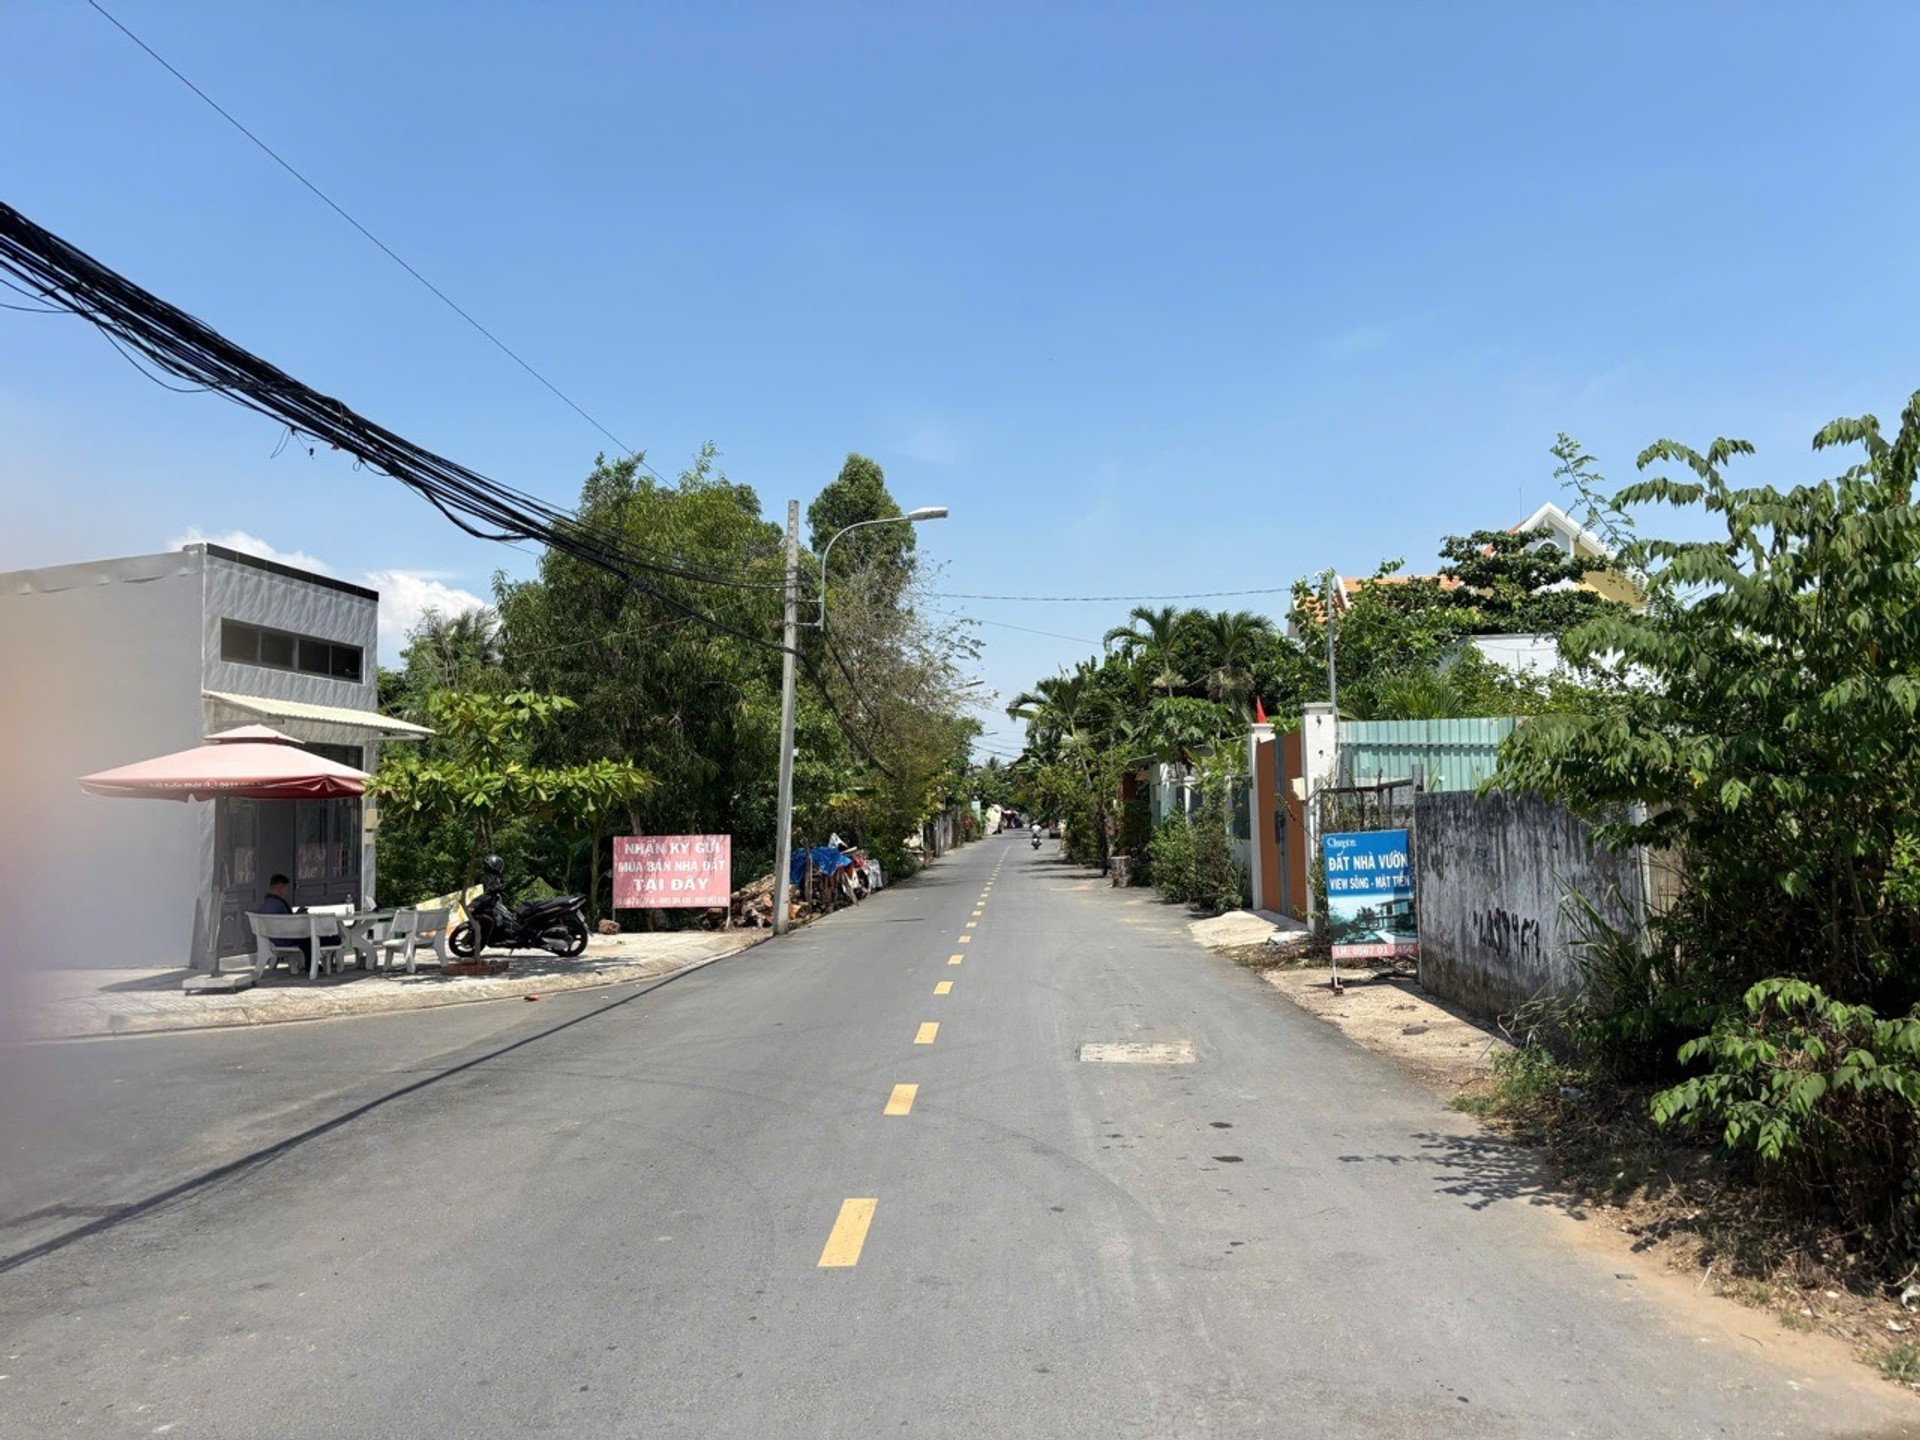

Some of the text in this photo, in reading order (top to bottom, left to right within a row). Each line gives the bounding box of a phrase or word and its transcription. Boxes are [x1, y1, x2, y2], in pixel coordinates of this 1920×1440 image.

[624, 840, 664, 856] NHẬN
[618, 861, 643, 872] MUA
[1328, 849, 1408, 871] ĐẤT NHÀ VƯỜN
[634, 875, 709, 893] TẠI ĐÂY
[1329, 878, 1349, 890] VIEW
[1349, 874, 1369, 890] SÔNG
[1375, 874, 1391, 891] MẶT
